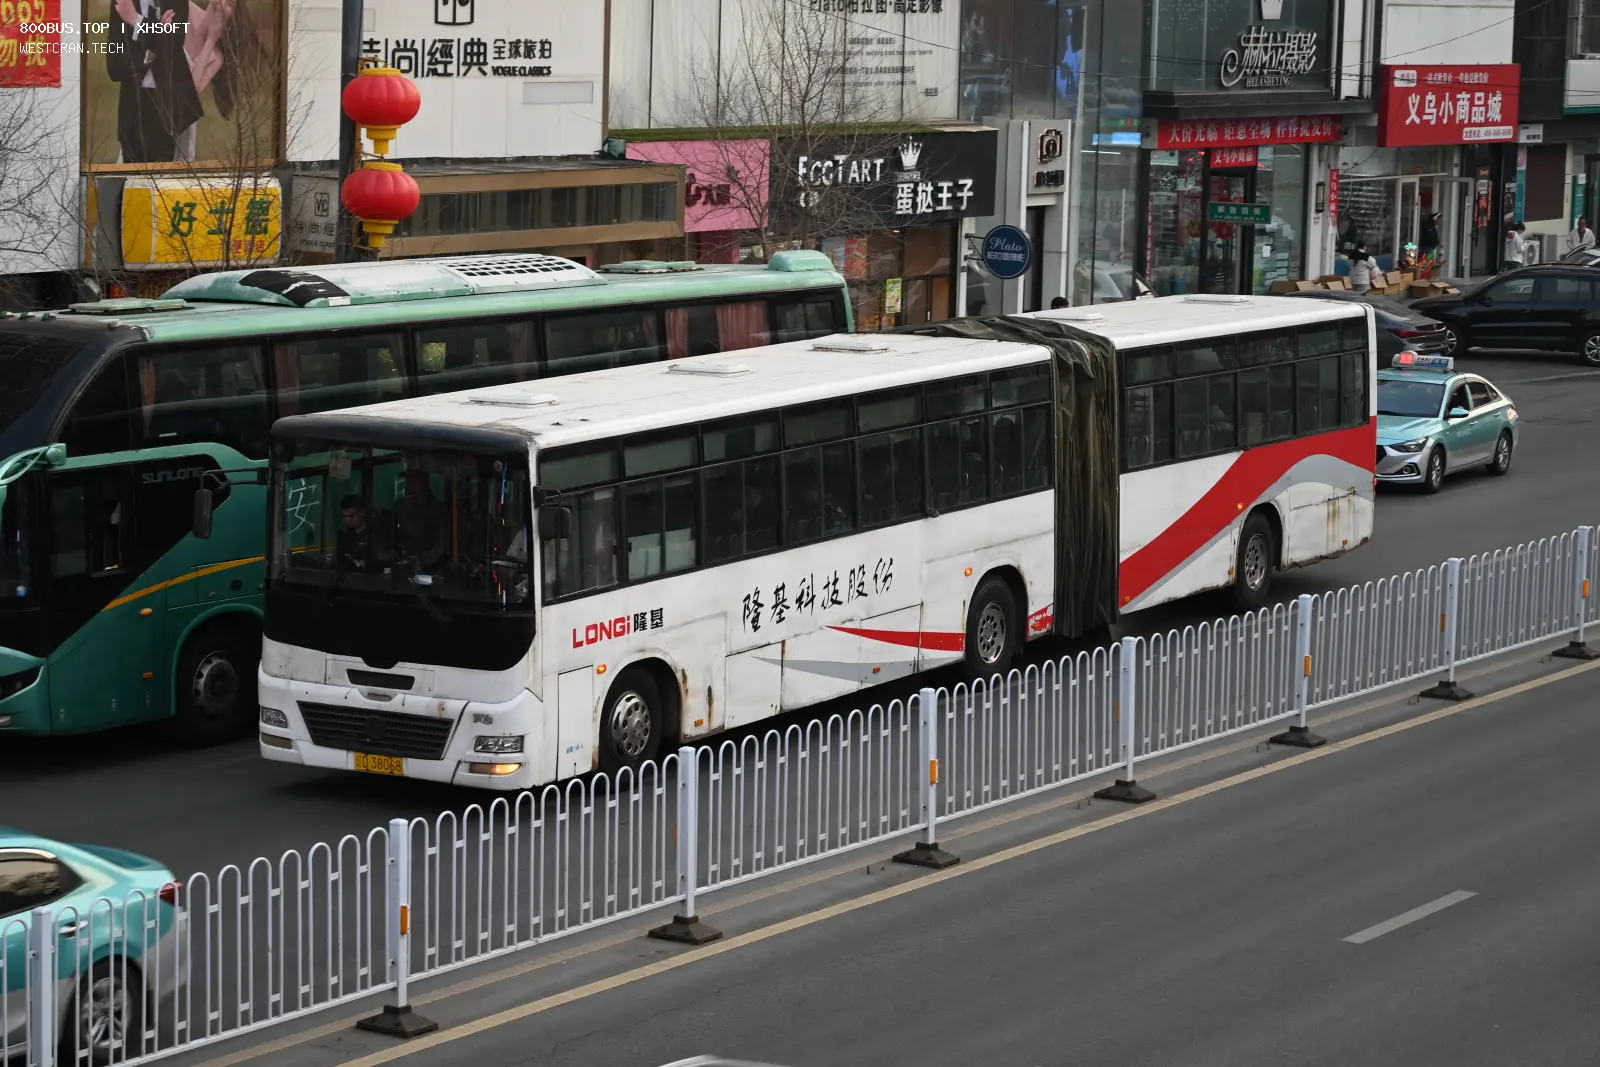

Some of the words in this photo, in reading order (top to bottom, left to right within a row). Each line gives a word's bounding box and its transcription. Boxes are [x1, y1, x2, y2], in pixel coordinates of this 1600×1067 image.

[493, 38, 552, 60] 全球旅拍
[491, 65, 518, 77] VOGUE
[1405, 90, 1503, 125] 义乌小商品城
[895, 178, 974, 215] 蛋挞王子
[990, 236, 1024, 251] Plato
[141, 466, 206, 484] SUNLONG
[742, 557, 894, 633] 隆基科技股份
[572, 615, 630, 649] LONGi
[633, 607, 664, 633] 隆基
